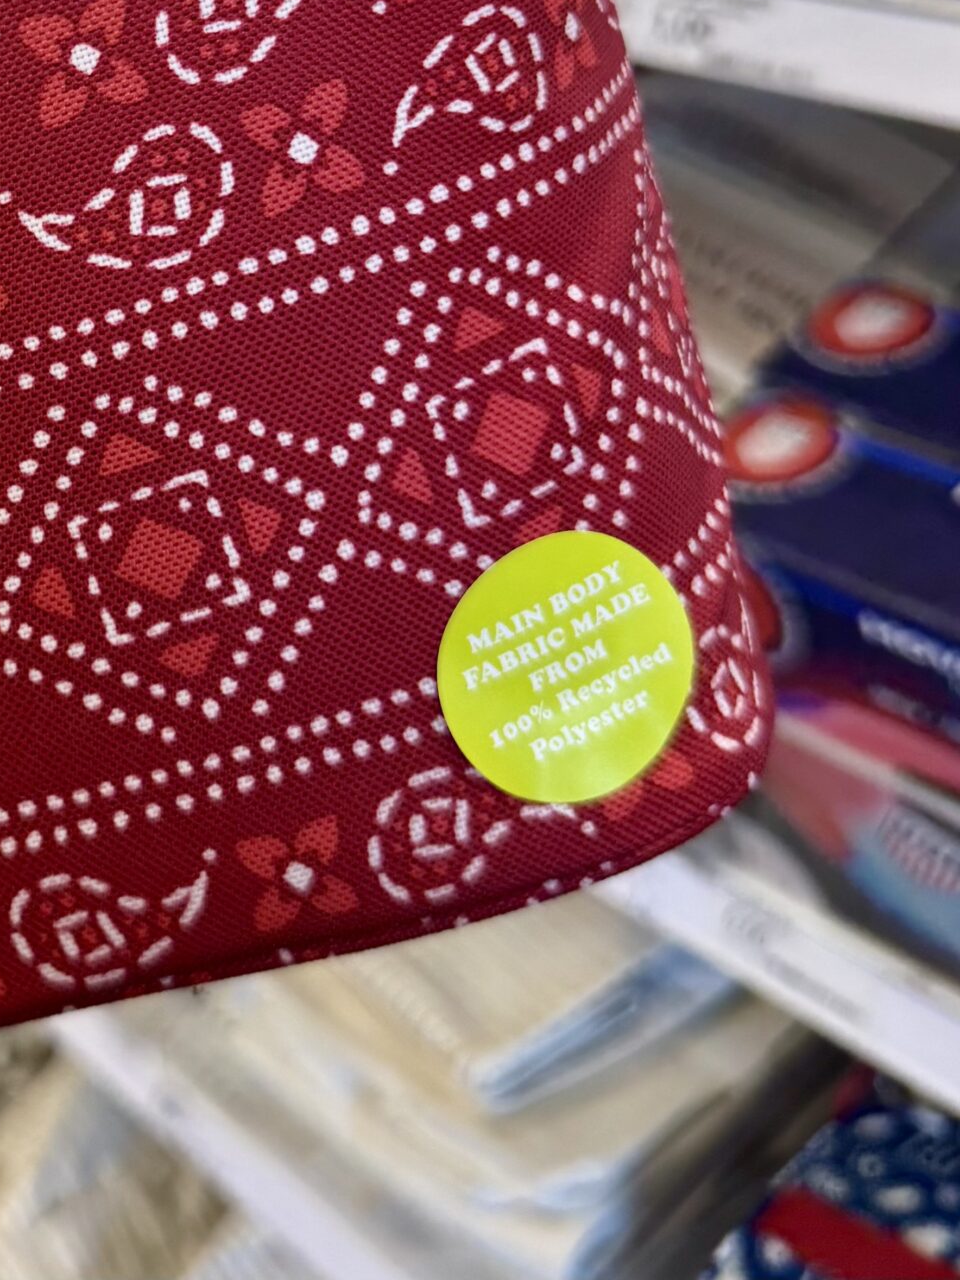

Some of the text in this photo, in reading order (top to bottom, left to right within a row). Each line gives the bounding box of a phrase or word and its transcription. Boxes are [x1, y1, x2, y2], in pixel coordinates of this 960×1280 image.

[462, 583, 651, 690] FABRIC MADE
[466, 561, 622, 653] MAIN BODY
[489, 643, 672, 748] 100% Recycled
[528, 639, 608, 692] FROM
[529, 690, 648, 761] Polyester
